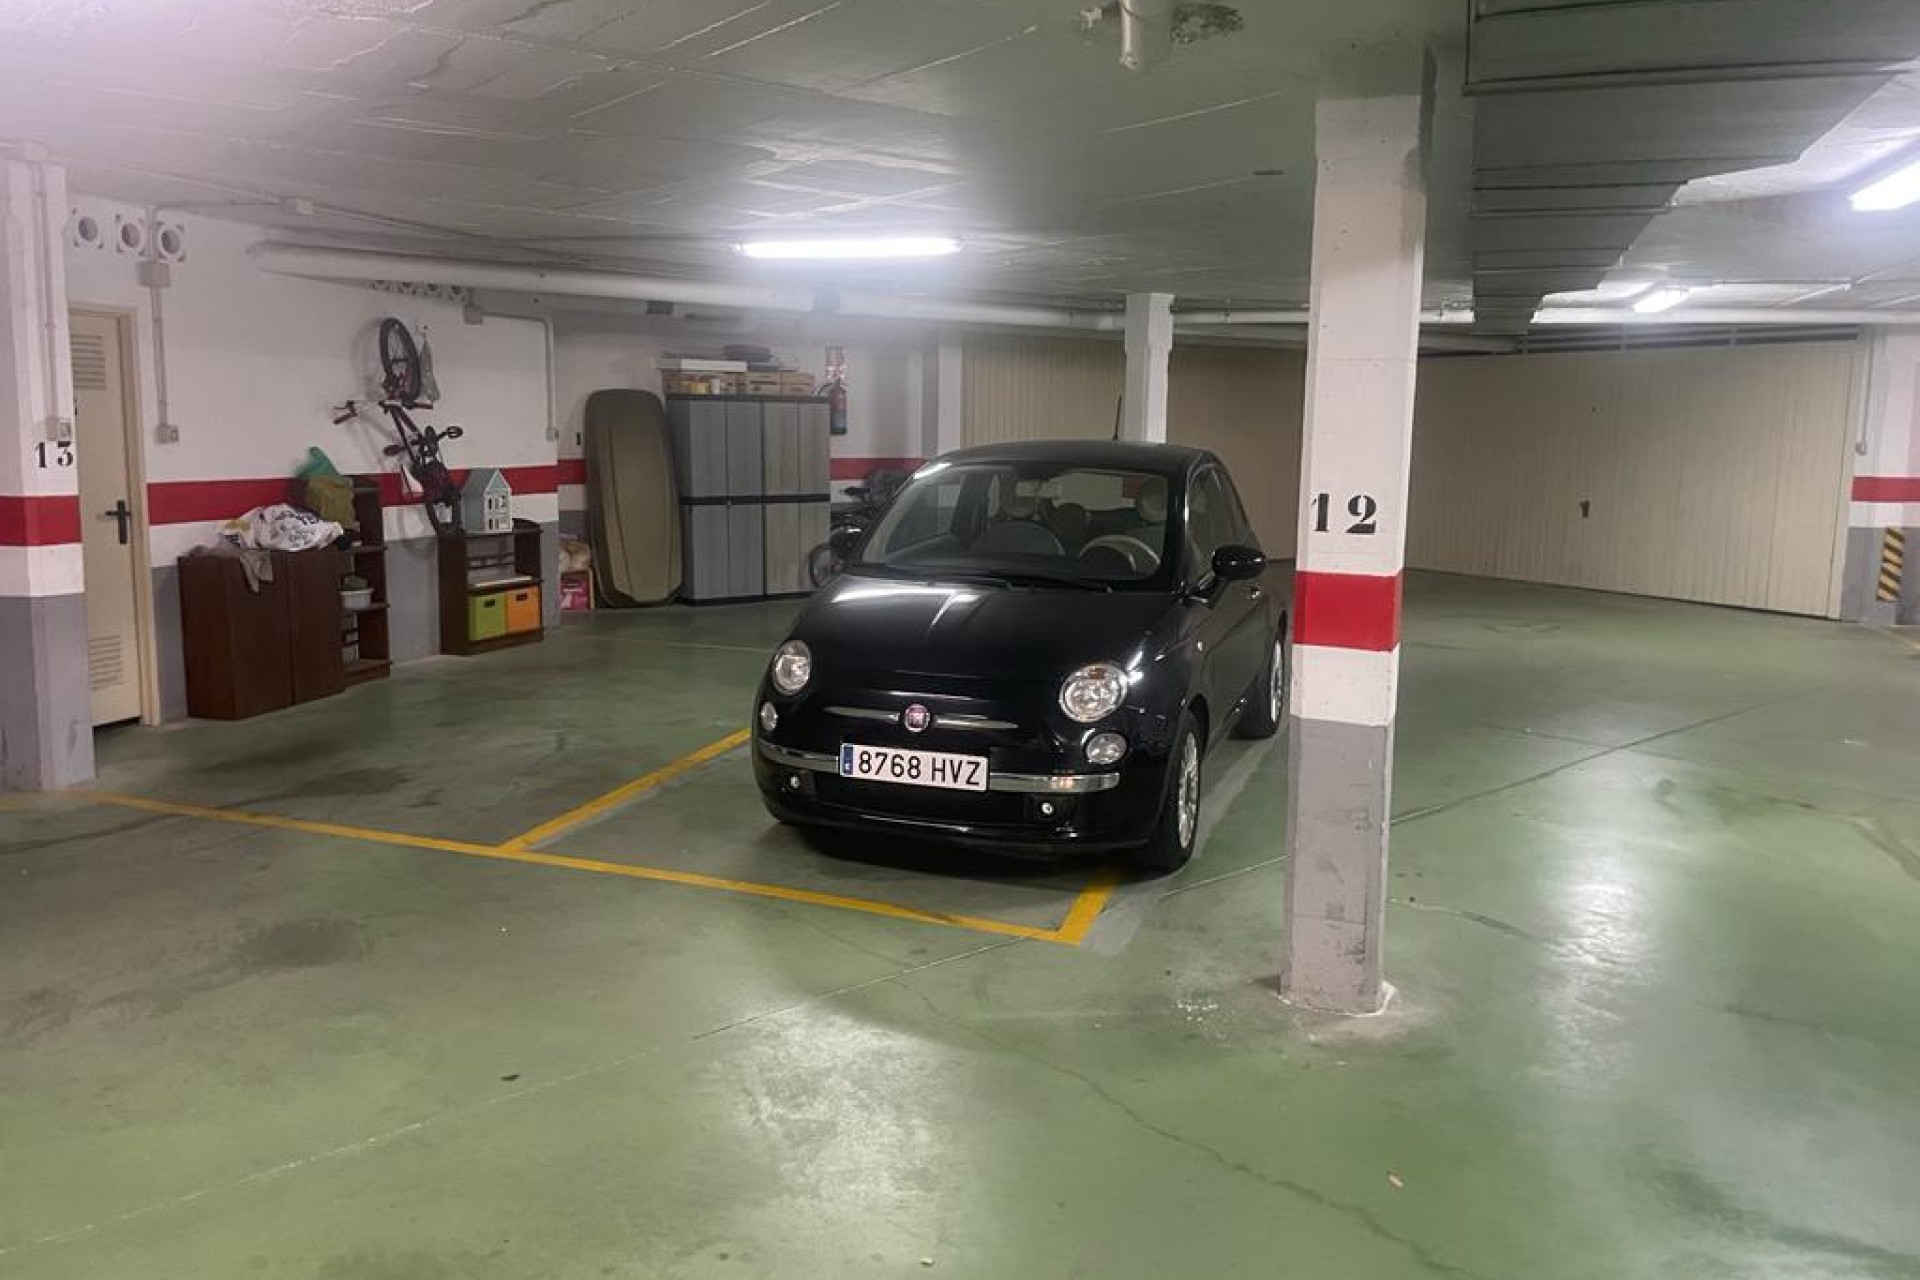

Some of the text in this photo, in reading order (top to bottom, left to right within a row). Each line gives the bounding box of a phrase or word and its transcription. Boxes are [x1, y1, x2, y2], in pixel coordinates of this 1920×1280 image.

[35, 440, 74, 468] 13
[1311, 493, 1377, 534] 12
[858, 750, 981, 787] 8768 HVZ
